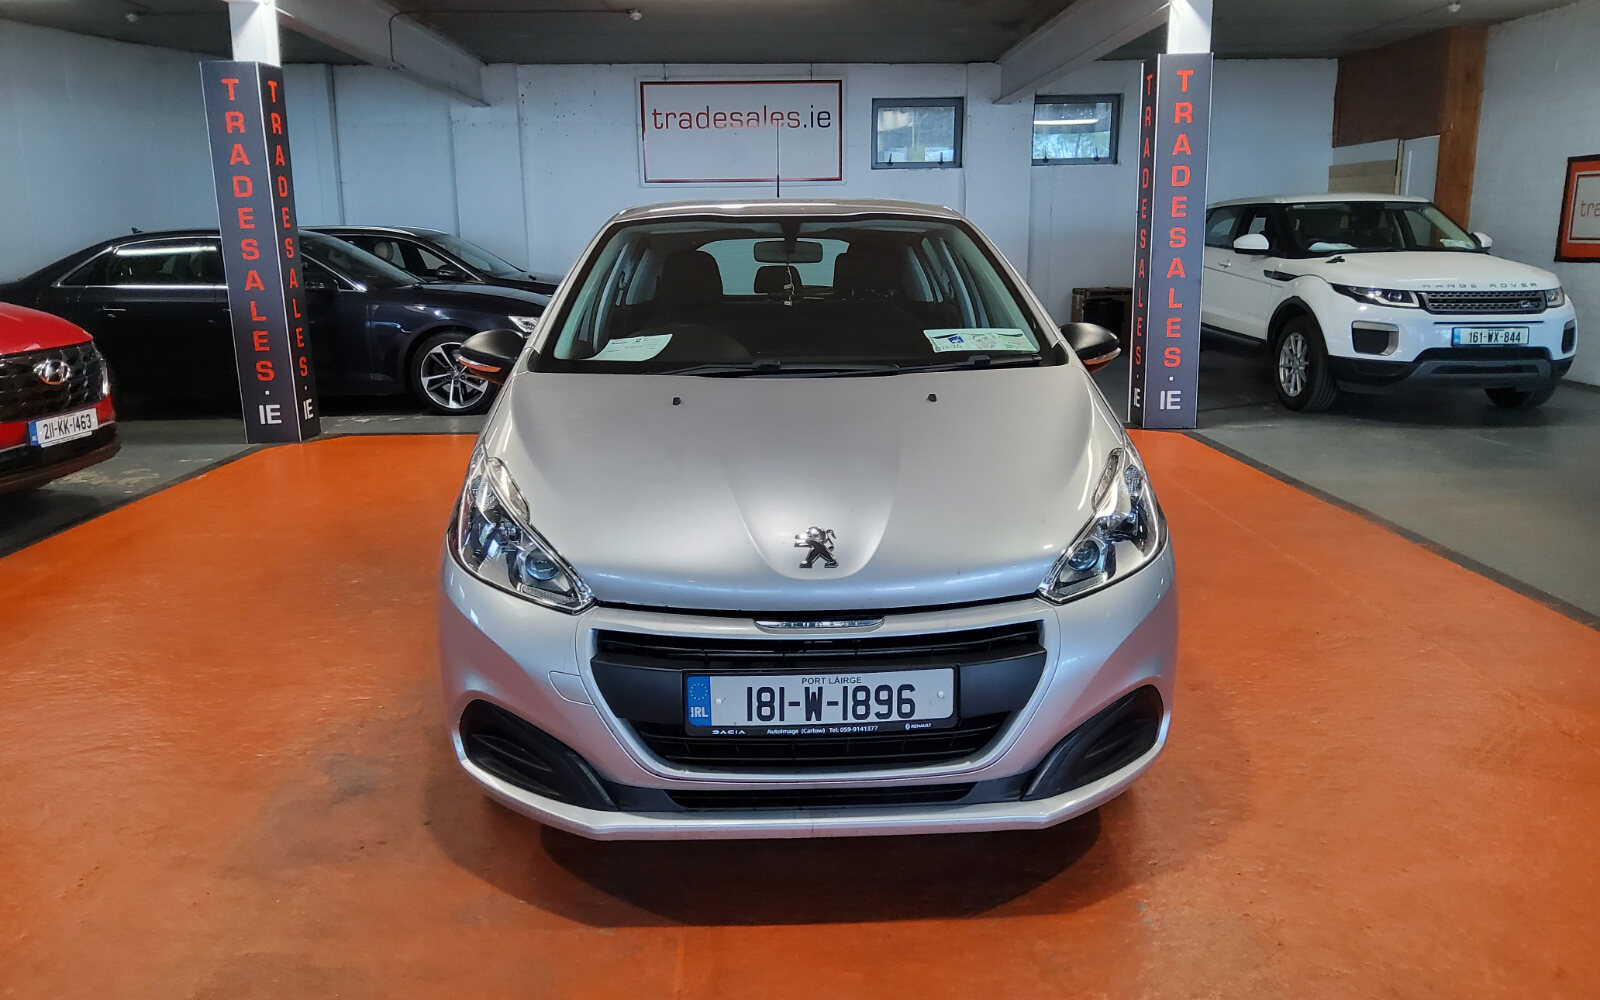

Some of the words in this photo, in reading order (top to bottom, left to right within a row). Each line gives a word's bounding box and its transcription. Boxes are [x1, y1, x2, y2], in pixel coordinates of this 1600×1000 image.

[651, 104, 831, 130] tradesales.ie
[221, 78, 282, 425] TRADESALES.IE
[267, 80, 314, 421] TRADESALES.IE
[1159, 69, 1194, 410] TRADESALES.IE
[1469, 331, 1521, 343] 161-WX-844
[43, 413, 92, 440] 211-KK-1463
[801, 677, 826, 685] PORT
[829, 676, 862, 684] LÁIRGE
[690, 706, 709, 718] IRL
[746, 684, 916, 722] 181-W-1896
[801, 727, 826, 735] (Carlow)
